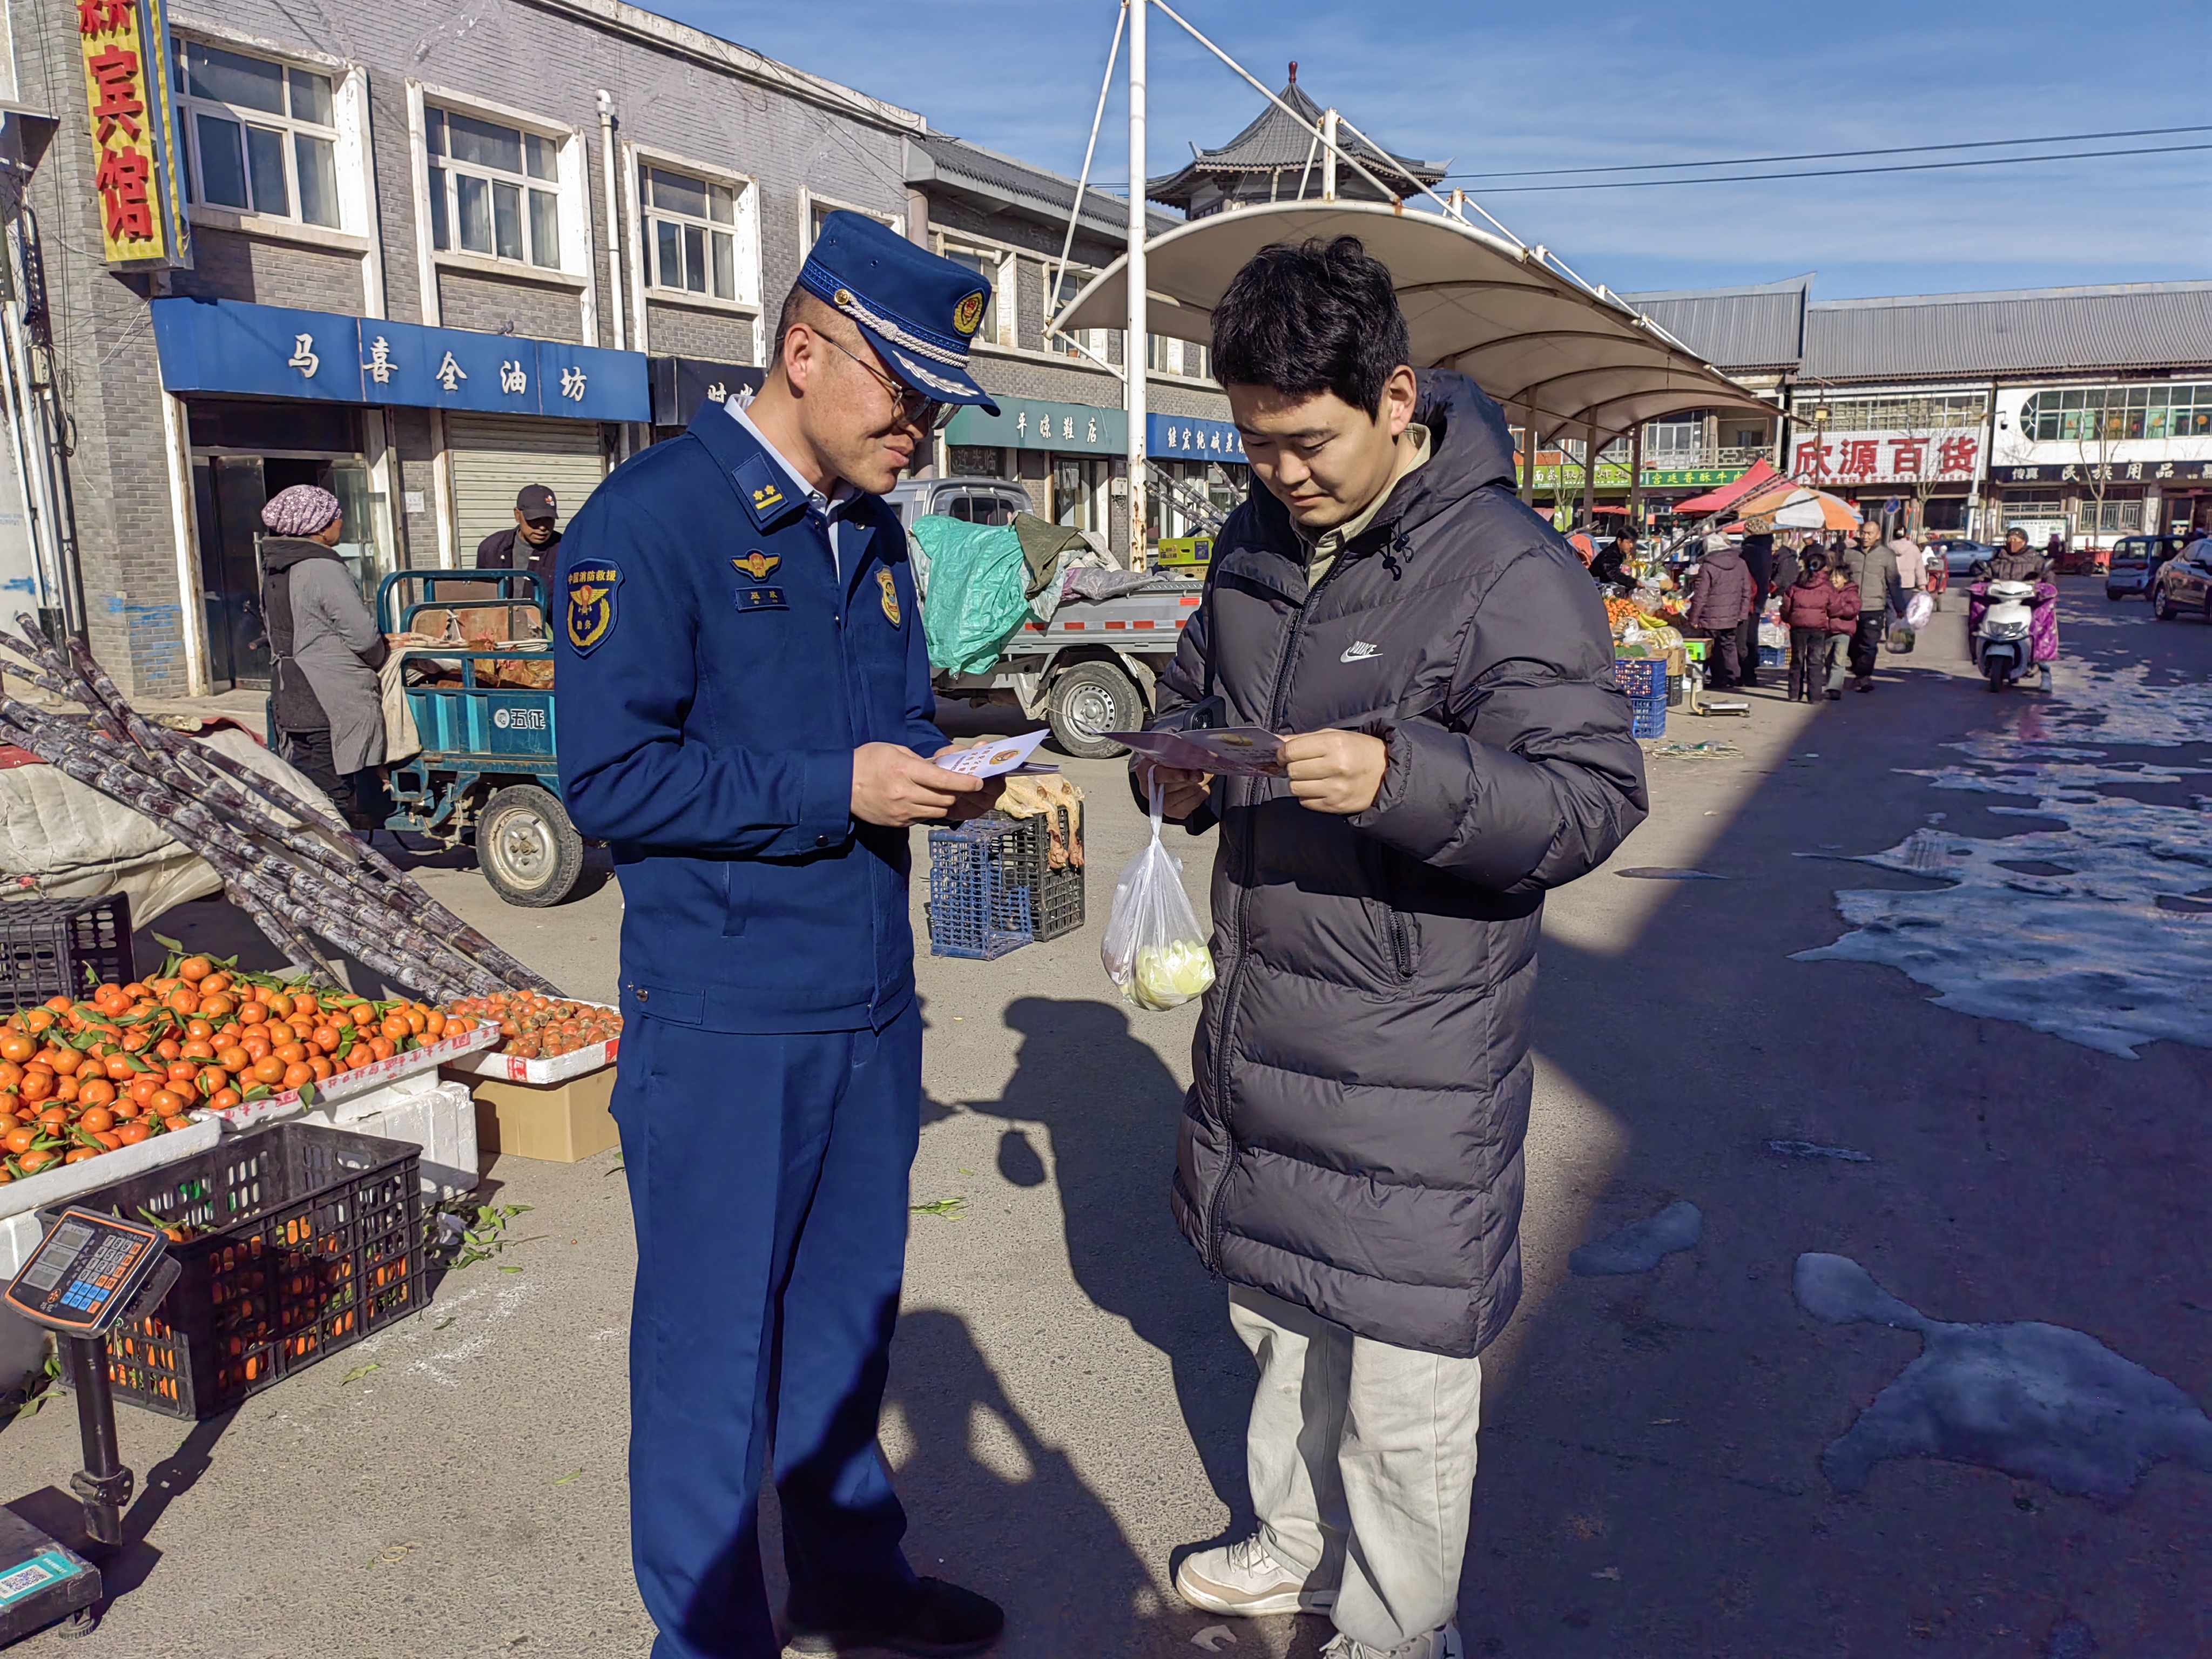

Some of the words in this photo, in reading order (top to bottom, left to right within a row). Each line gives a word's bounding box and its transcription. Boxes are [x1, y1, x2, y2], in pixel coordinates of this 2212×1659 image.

[288, 333, 588, 402] 马喜全油坊
[1016, 412, 1097, 444] 平凉鞋店
[952, 449, 996, 471] 迎光临
[1793, 436, 1979, 477] 欣源百货
[1520, 469, 1559, 482] 面茶
[2061, 462, 2175, 482] 民族用品
[568, 570, 616, 584] 中国消防救援
[1349, 640, 1378, 656] NIKE
[510, 709, 546, 730] 五征
